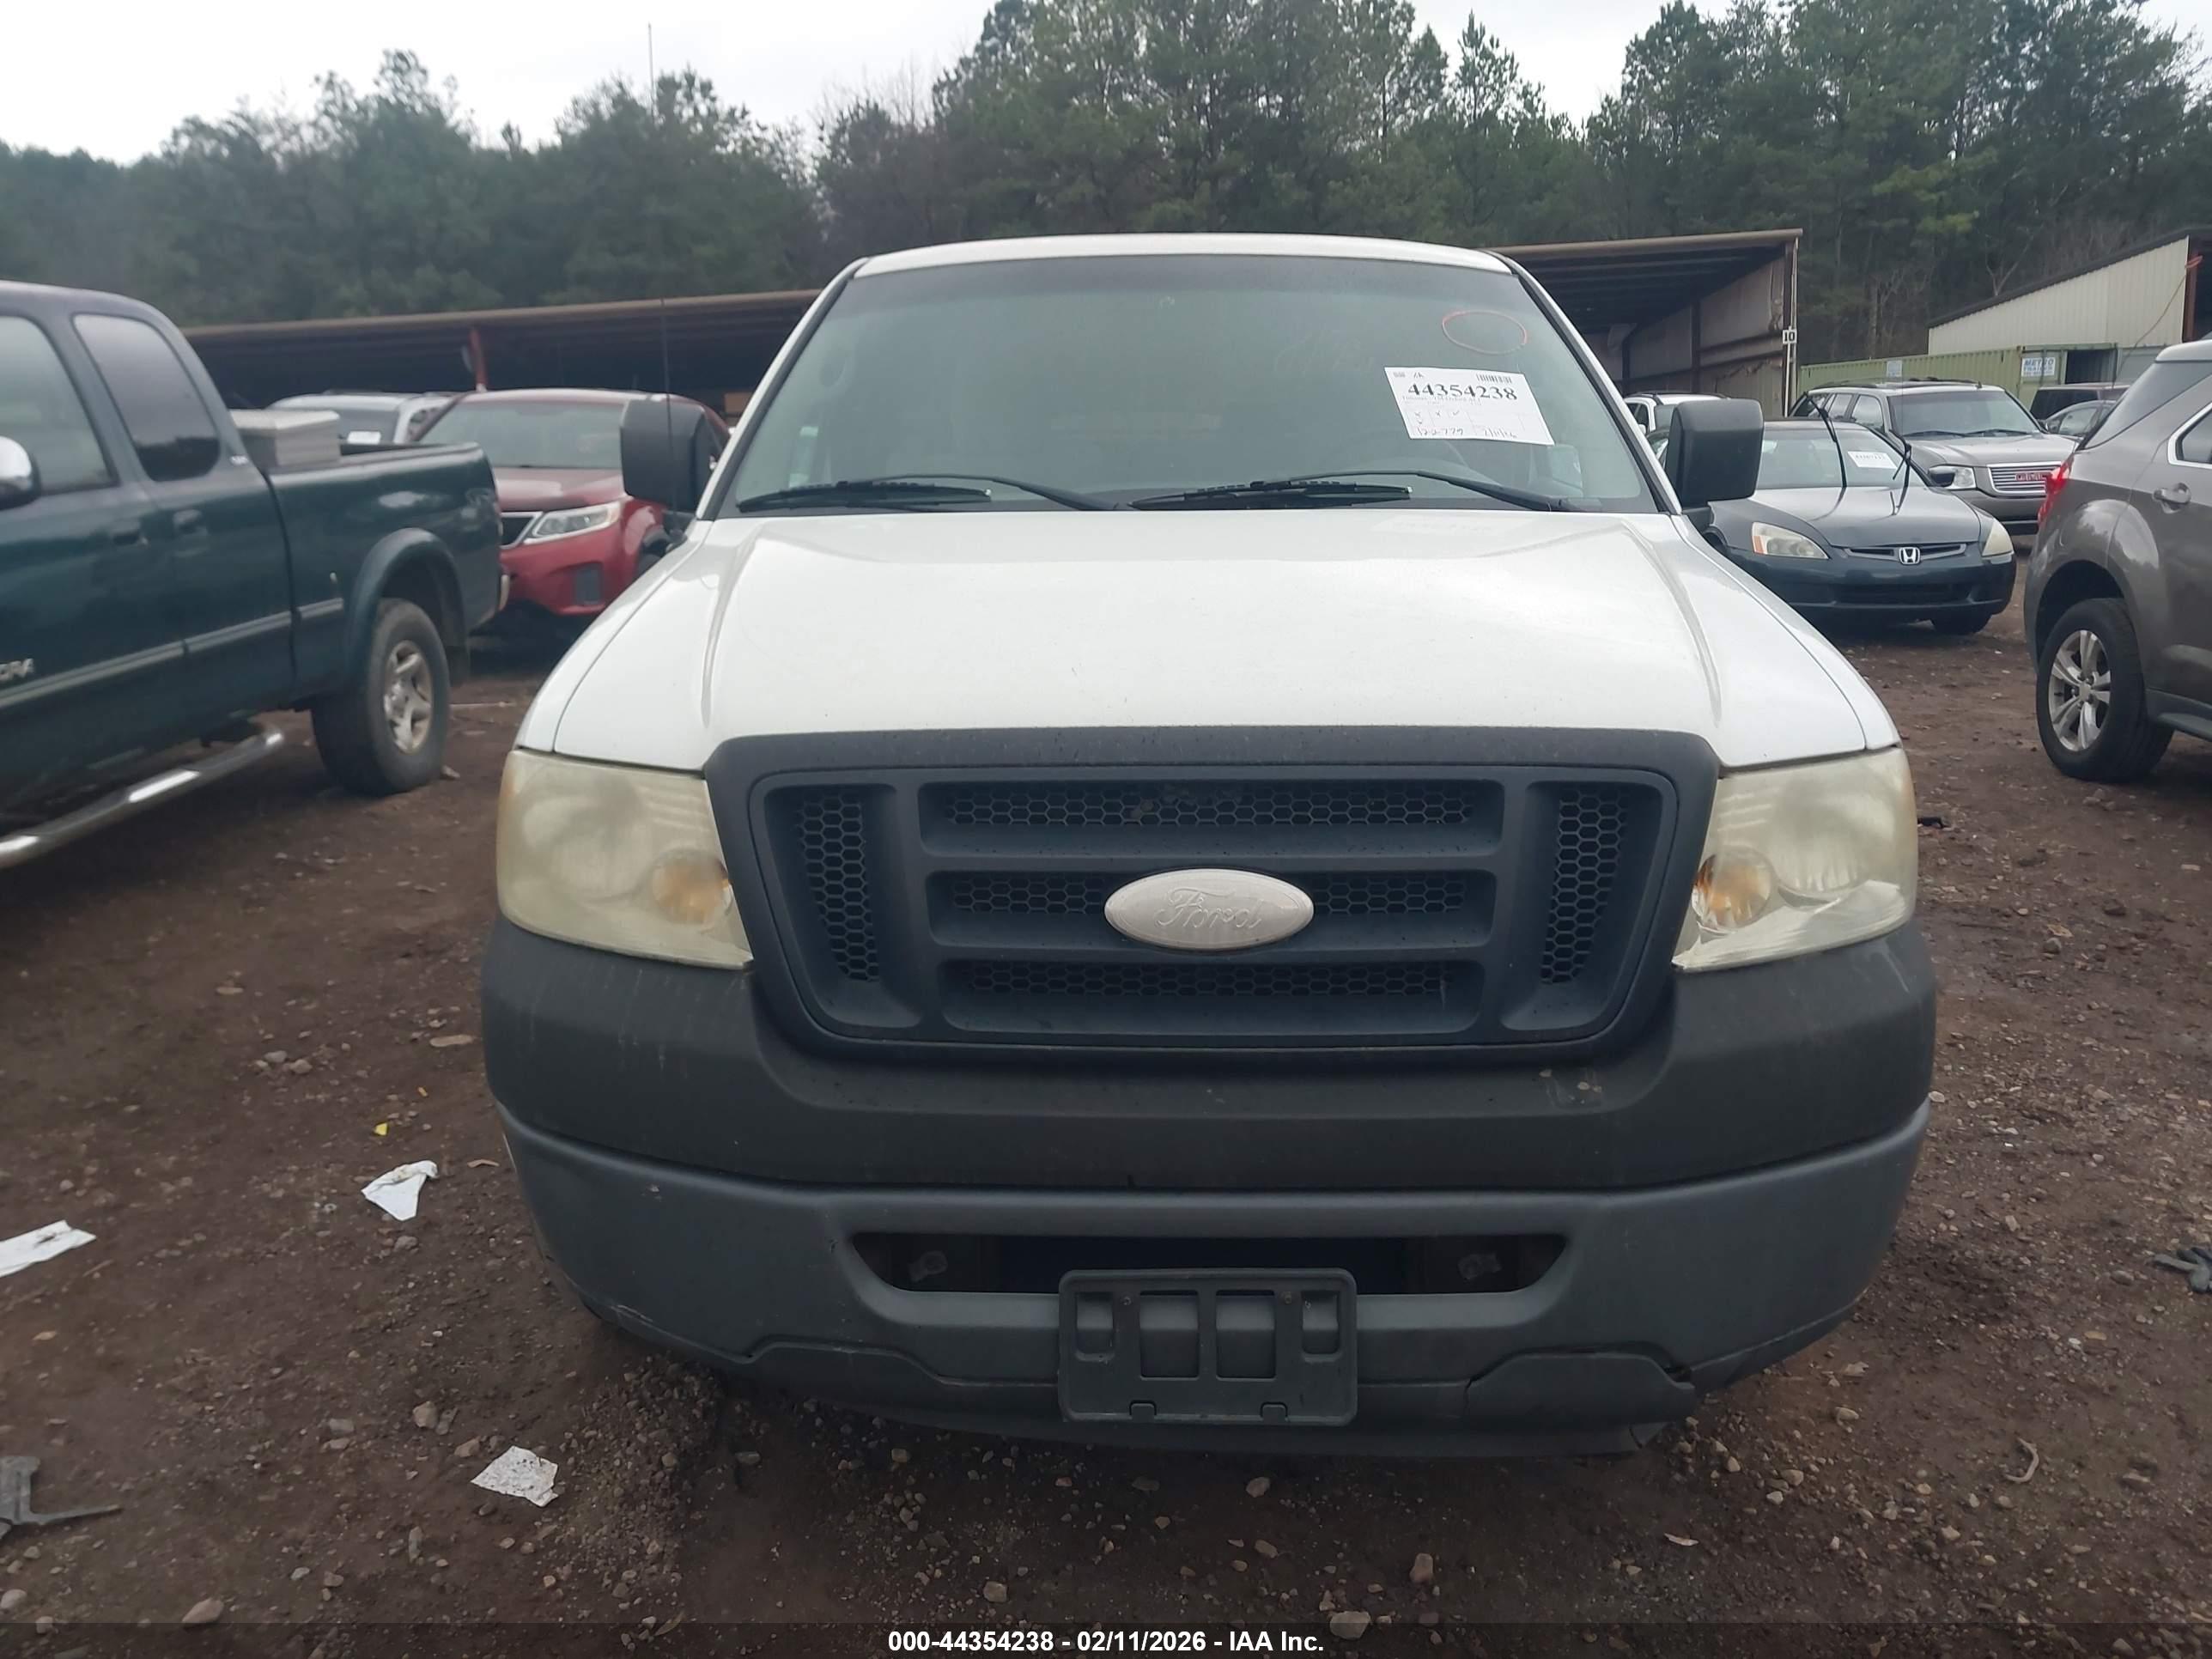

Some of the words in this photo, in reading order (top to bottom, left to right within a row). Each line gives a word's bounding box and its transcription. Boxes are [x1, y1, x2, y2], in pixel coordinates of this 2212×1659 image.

[1784, 331, 1796, 342] 10
[1408, 383, 1518, 401] 44354238
[1155, 887, 1263, 929] Ford
